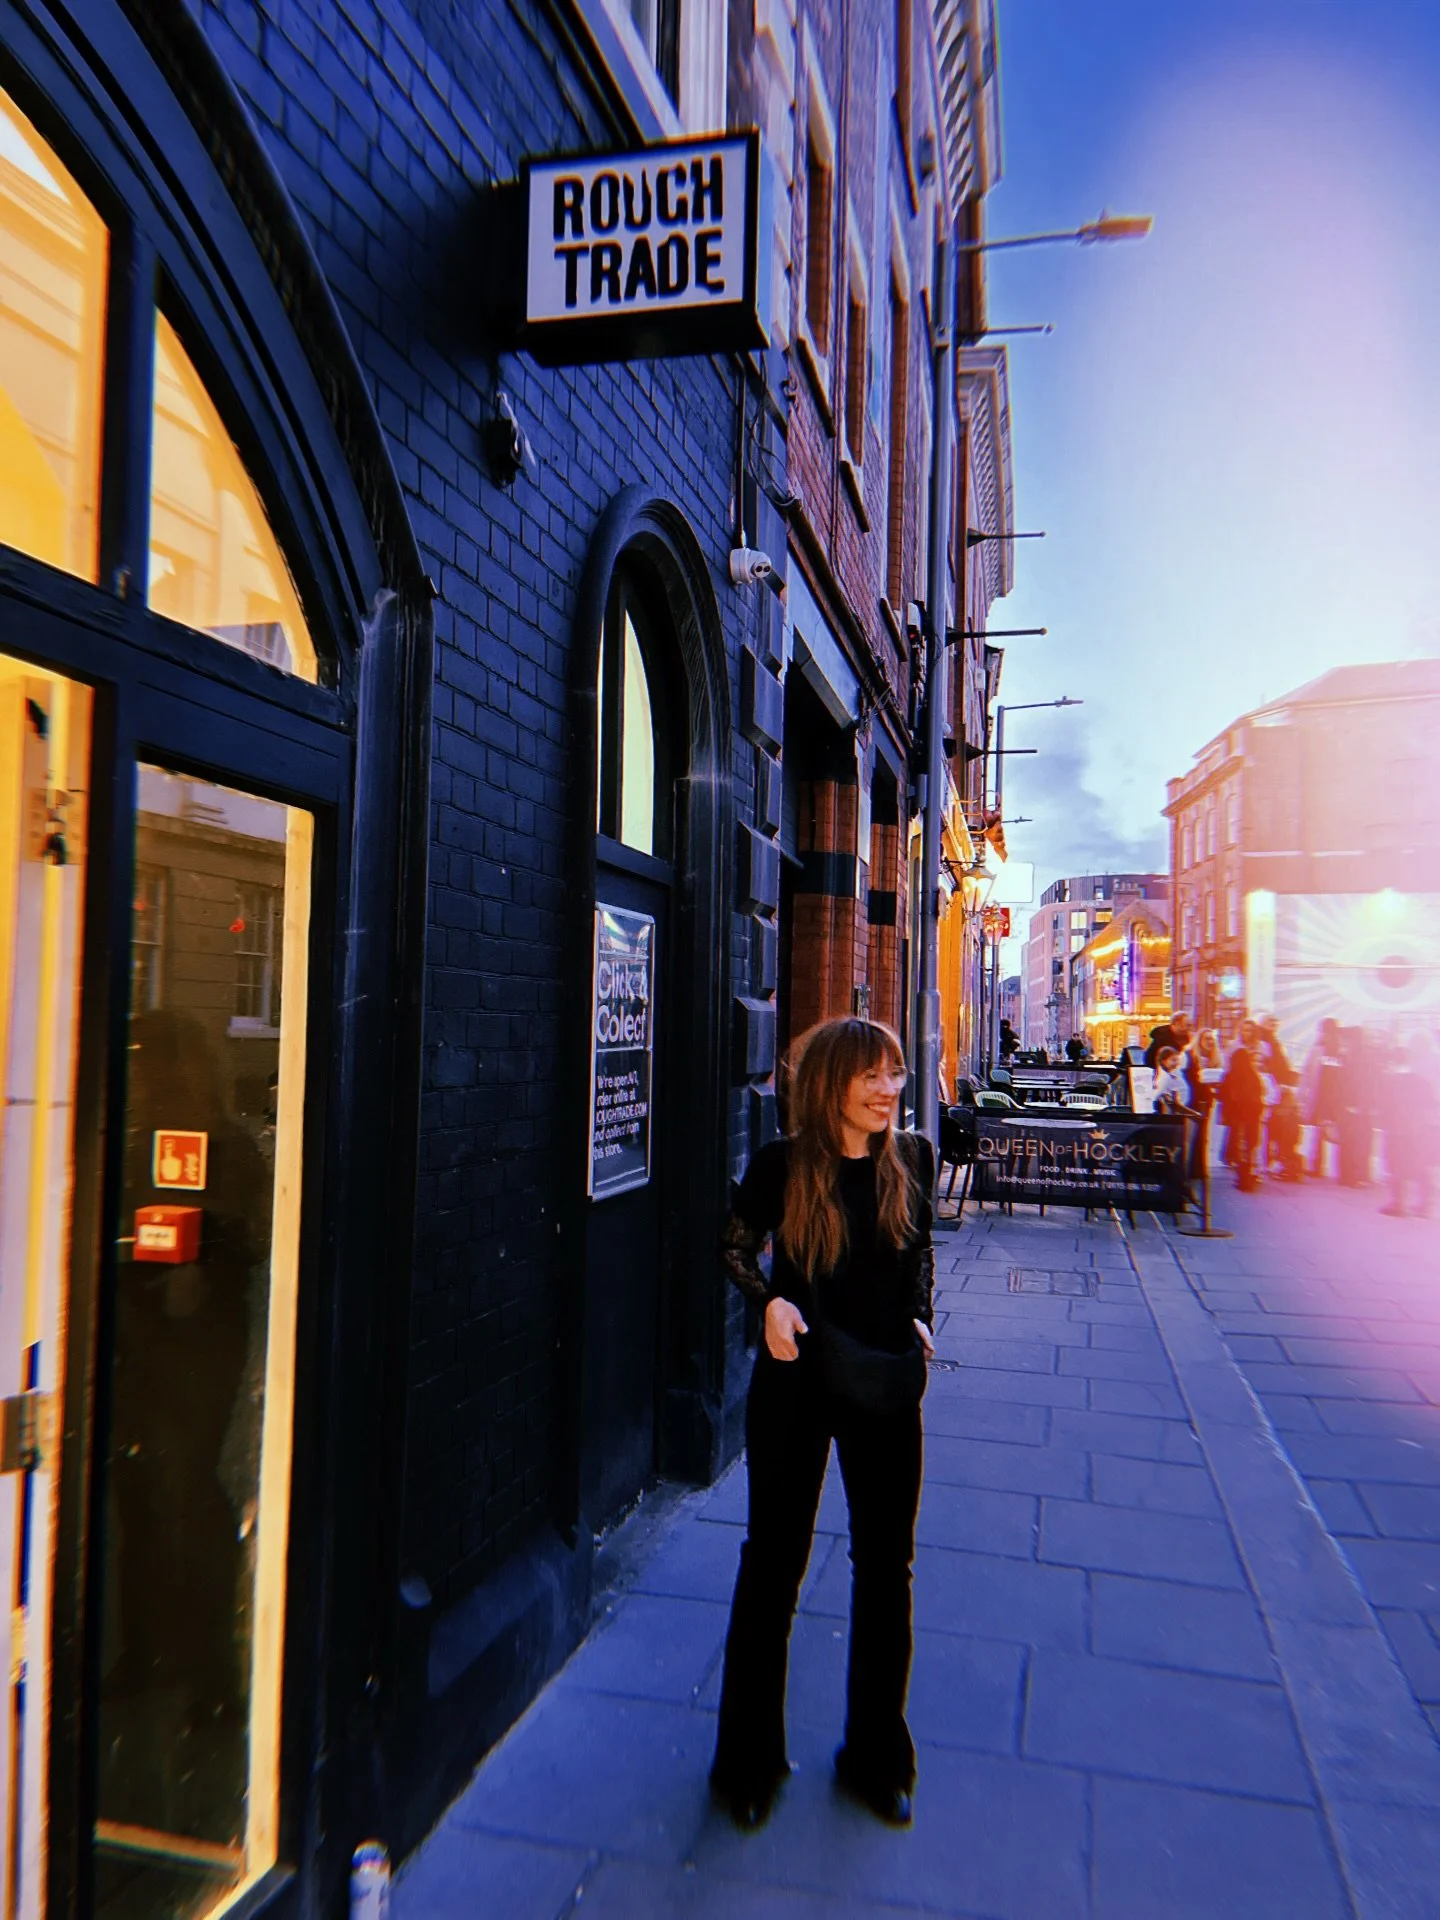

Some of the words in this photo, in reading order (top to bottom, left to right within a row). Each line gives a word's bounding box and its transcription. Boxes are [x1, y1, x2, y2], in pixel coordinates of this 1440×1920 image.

[553, 154, 723, 240] ROUGH
[554, 227, 725, 309] TRADE
[598, 961, 634, 1003] Click
[597, 1091, 612, 1106] rder
[596, 1102, 647, 1123] OUGHTRADE.COM
[978, 1137, 1054, 1158] QUEEN
[1055, 1145, 1072, 1155] OF
[1073, 1140, 1181, 1163] HOCKLEY
[1040, 1165, 1060, 1173] FOOD
